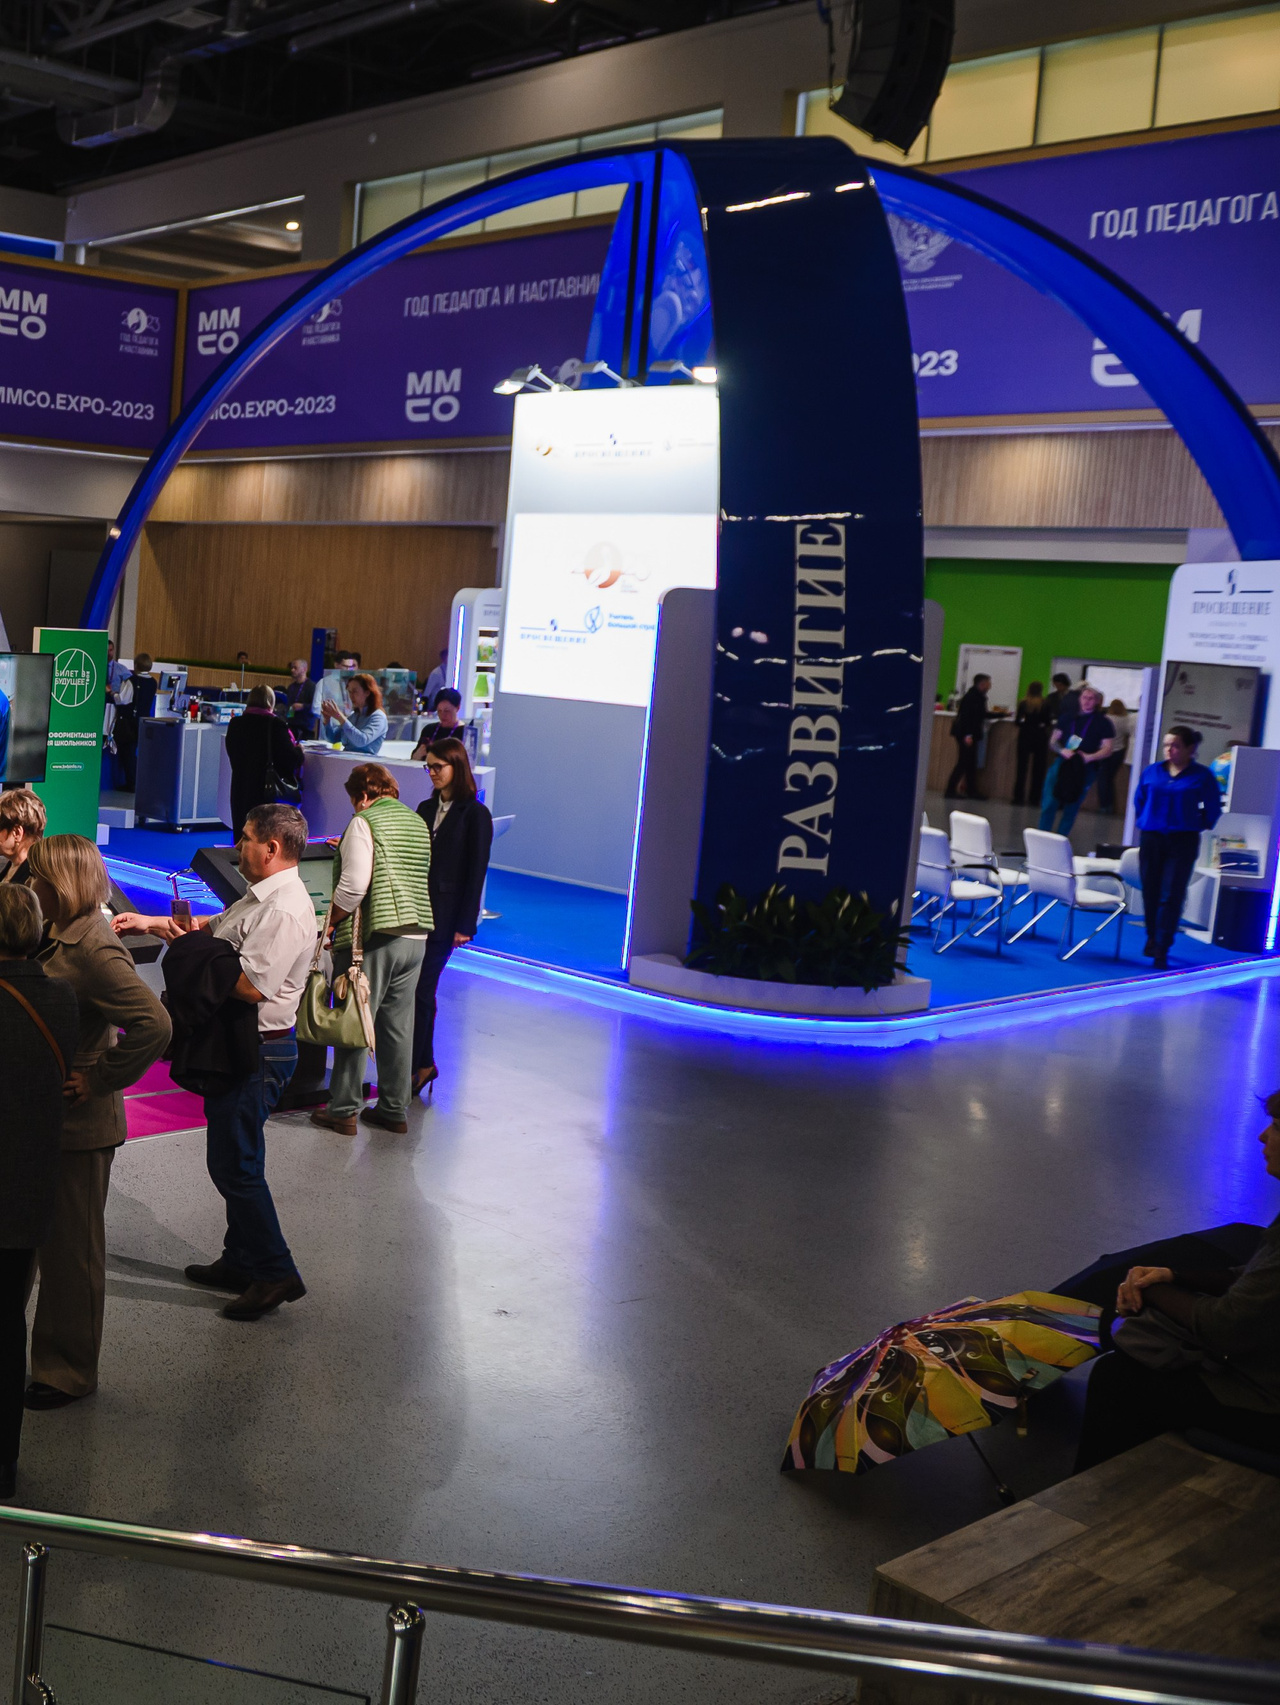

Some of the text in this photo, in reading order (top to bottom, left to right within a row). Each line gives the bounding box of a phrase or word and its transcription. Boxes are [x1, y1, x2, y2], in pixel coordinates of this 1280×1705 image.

[1089, 191, 1279, 241] ГОД ПЕДАГОГА
[403, 272, 601, 318] ГОД ПЕДАГОГА И НАСТАВНИ
[210, 394, 337, 420] CO.EXPO-2023
[775, 522, 846, 877] РАЗВИТИЕ
[48, 731, 97, 739] ОФОРИЕНТАЦИЯ
